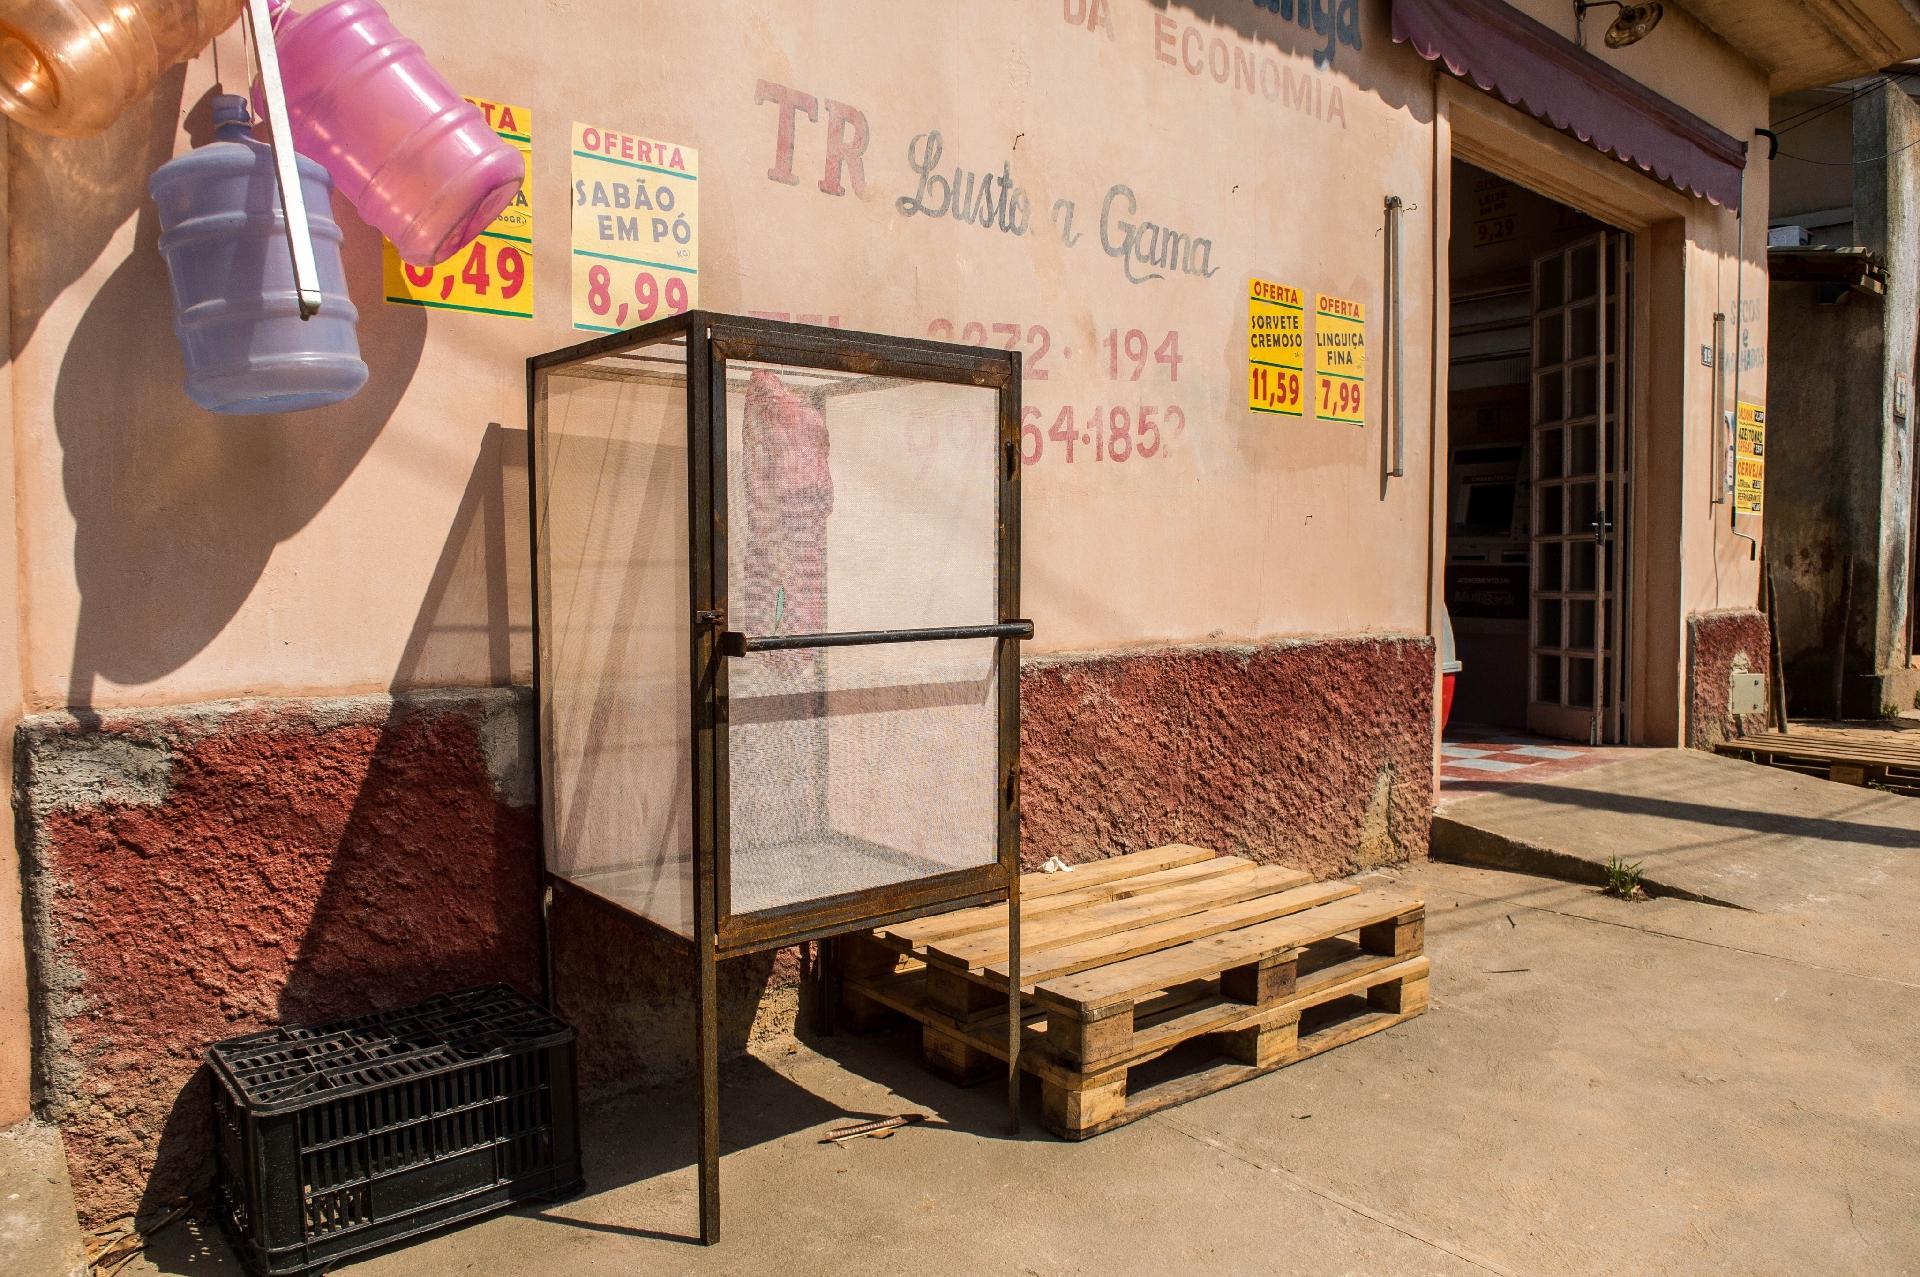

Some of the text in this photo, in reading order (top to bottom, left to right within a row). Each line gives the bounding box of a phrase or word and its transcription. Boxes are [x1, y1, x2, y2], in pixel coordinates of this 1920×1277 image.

[1154, 12, 1346, 129] ECONOMIA
[582, 127, 686, 171] OFERTA
[576, 178, 675, 211] SABÃO
[754, 79, 870, 200] TR
[1100, 184, 1221, 284] Gama
[598, 212, 691, 245] EM PÓ
[588, 264, 689, 327] 8,99
[1254, 281, 1298, 304] OFERTA
[1320, 296, 1360, 318] OFERTA
[1251, 315, 1299, 330] SORVETE
[1103, 329, 1183, 382] 194
[1251, 333, 1303, 348] CREMOSO
[1316, 333, 1364, 349] LINGUIÇA
[1327, 351, 1353, 366] FINA
[1252, 367, 1300, 407] 11,59
[1322, 378, 1361, 416] 7,99
